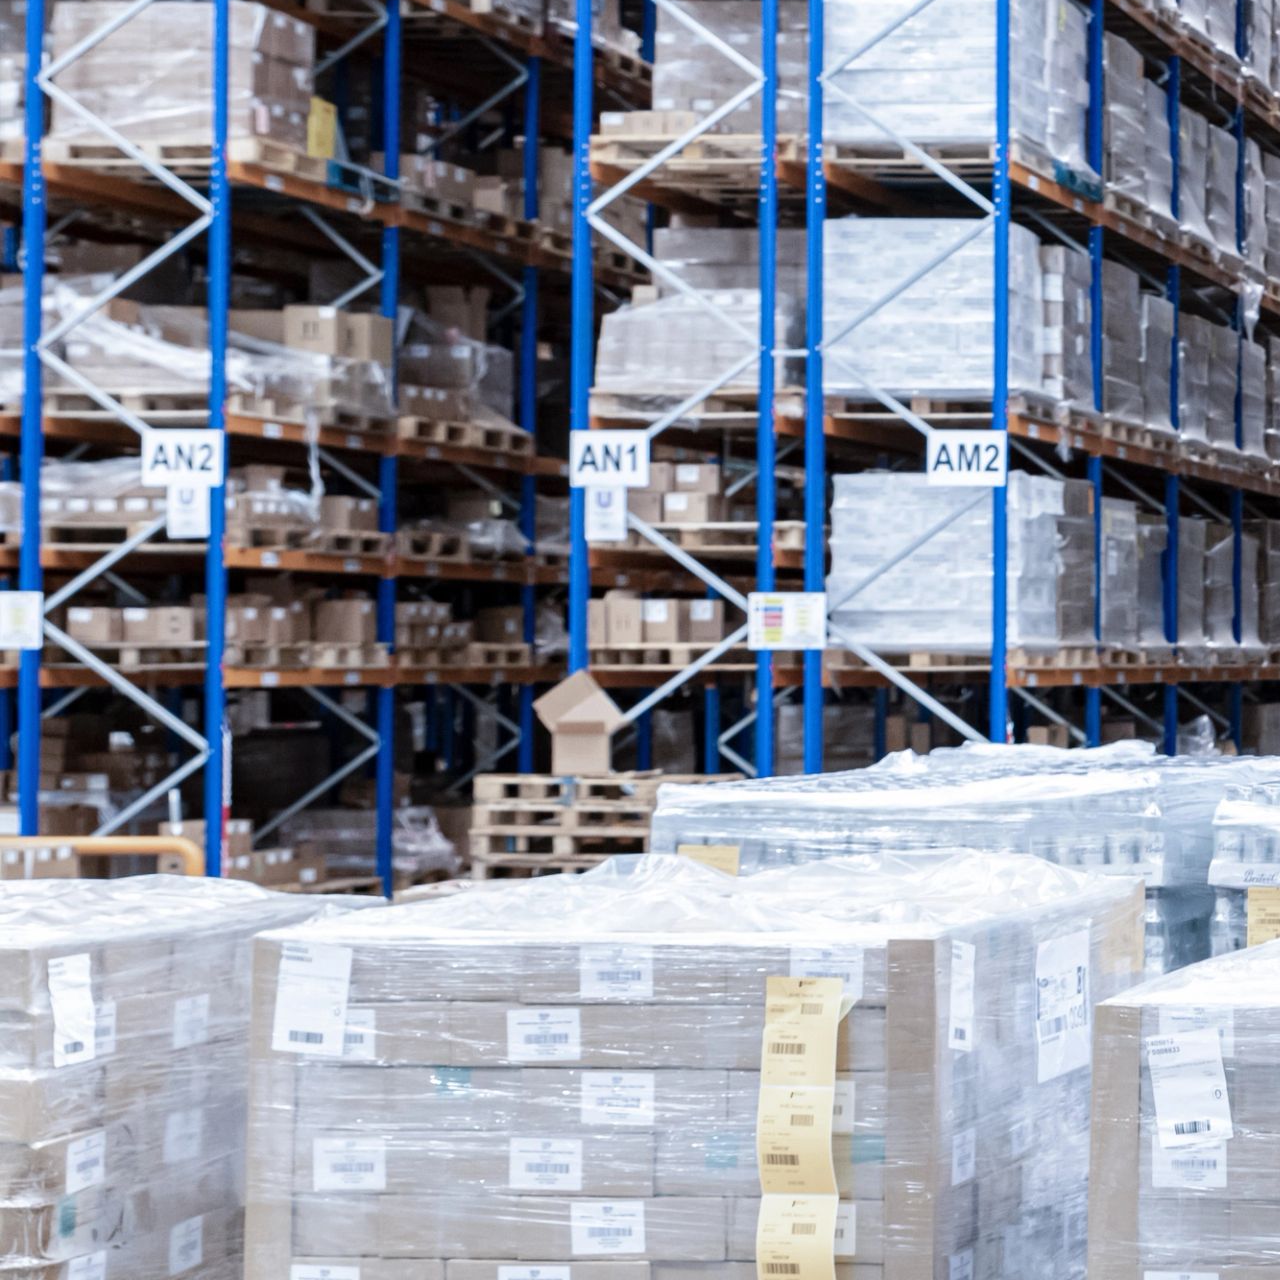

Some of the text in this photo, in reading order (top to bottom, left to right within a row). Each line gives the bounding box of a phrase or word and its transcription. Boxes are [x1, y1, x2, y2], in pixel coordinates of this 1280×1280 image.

[151, 444, 213, 471] AN2
[578, 443, 639, 471] AN1
[934, 443, 999, 471] AM2
